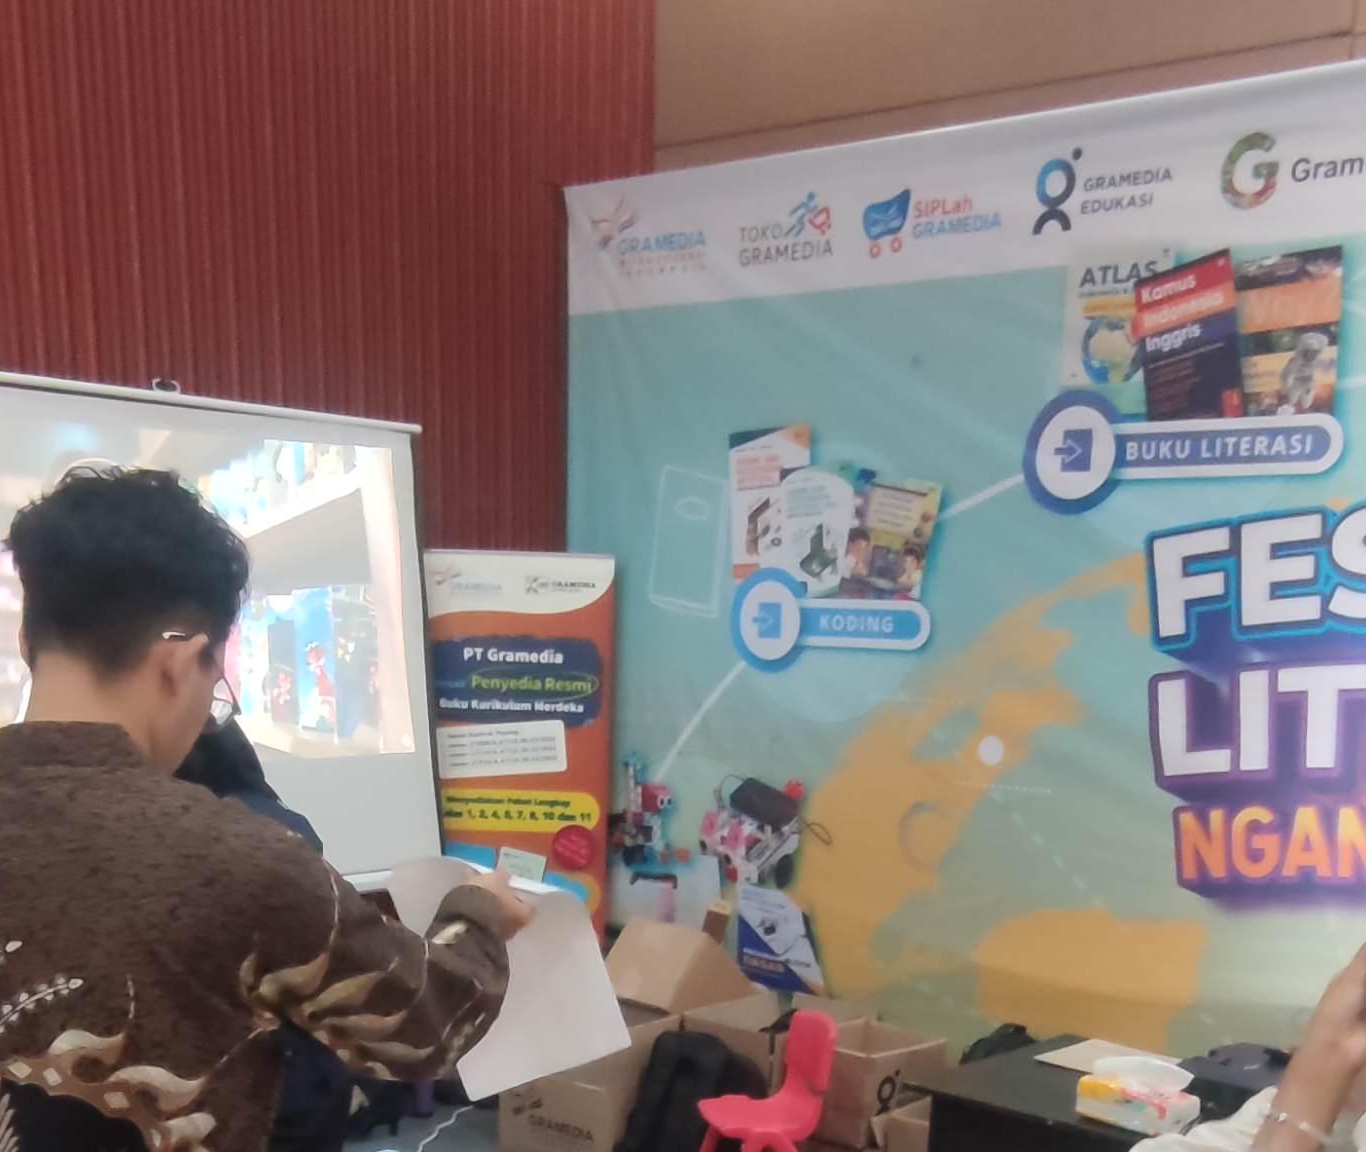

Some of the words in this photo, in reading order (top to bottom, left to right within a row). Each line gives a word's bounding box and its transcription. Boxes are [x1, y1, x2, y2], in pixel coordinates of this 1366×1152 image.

[1083, 168, 1173, 193] GRAMEDIA
[913, 195, 973, 218] SIPLah
[1080, 194, 1154, 215] EDUKASI
[739, 223, 783, 244] TOKO
[912, 212, 1002, 239] GRAMEDIA
[739, 239, 834, 268] GRAMEDIA
[1140, 274, 1197, 305] Kamus
[1145, 321, 1202, 353] Inggris
[1125, 437, 1191, 461] BUKU
[1201, 433, 1314, 458] LITERASI
[819, 614, 894, 633] KODING
[463, 647, 483, 661] PT
[487, 647, 564, 664] Gramedia
[471, 675, 541, 692] Penyedia
[471, 699, 532, 711] Kurikulum
[535, 701, 585, 713] Merdeka
